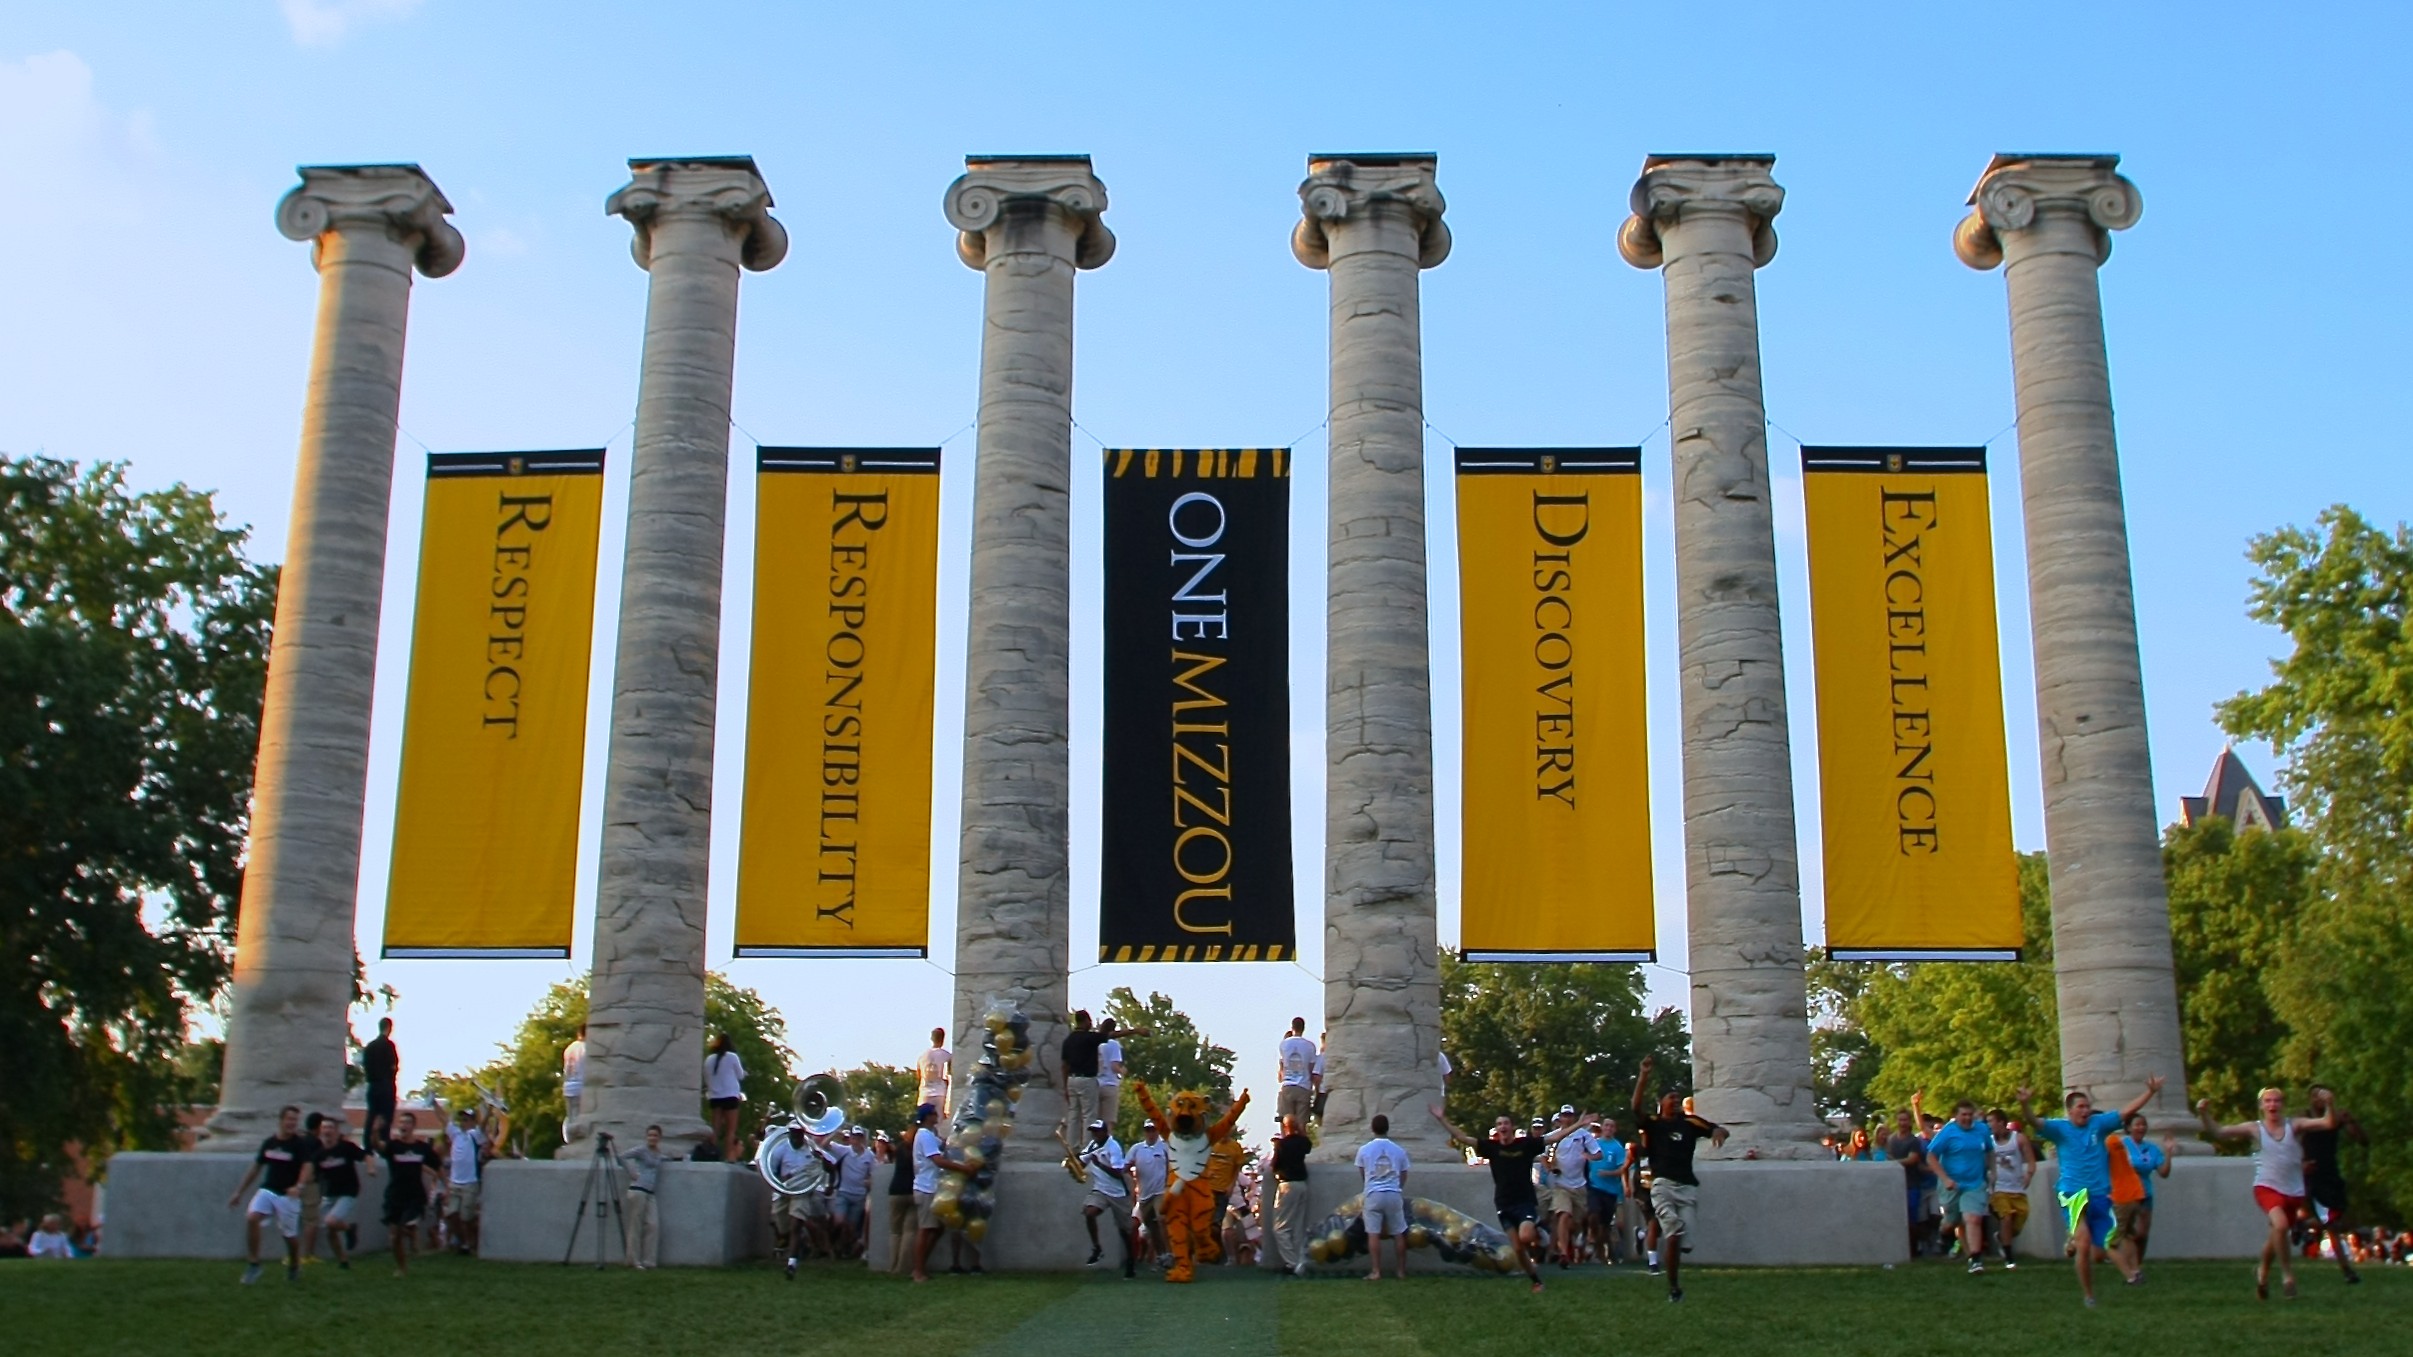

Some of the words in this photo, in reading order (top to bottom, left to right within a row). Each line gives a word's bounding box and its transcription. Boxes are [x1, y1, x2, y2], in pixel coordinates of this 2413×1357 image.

[482, 490, 553, 741] RESPECT
[815, 487, 889, 930] RESPONSIBILITY
[1532, 488, 1590, 811] DISCOVERY
[1879, 484, 1939, 857] EXCELLENCE
